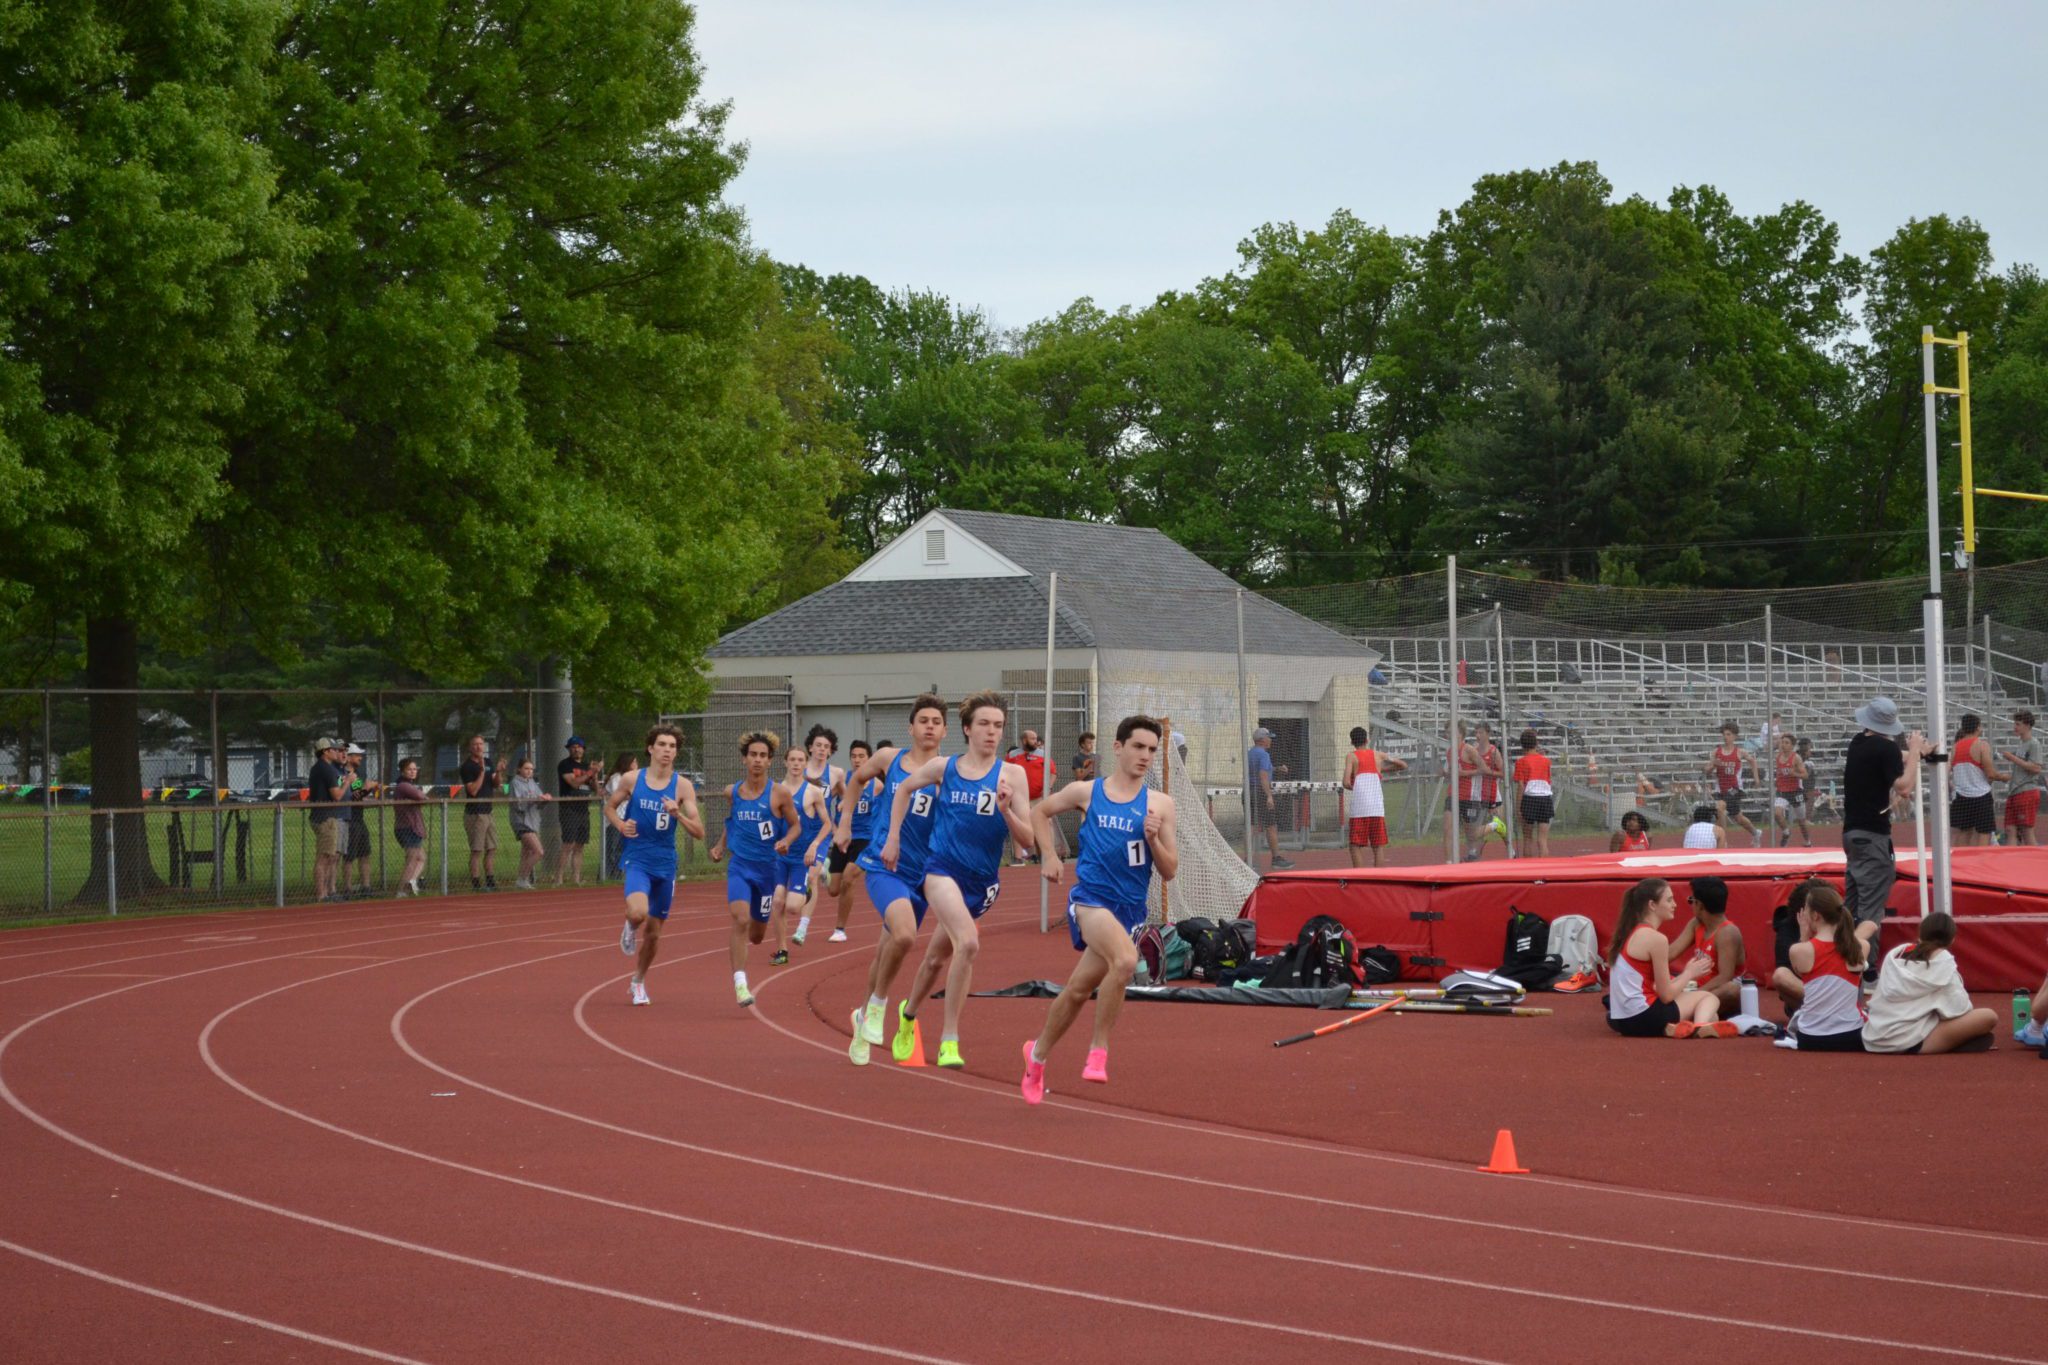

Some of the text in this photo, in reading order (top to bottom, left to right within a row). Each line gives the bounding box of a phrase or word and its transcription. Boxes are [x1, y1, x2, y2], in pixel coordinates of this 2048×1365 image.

[861, 802, 868, 813] 9
[915, 795, 928, 813] 3
[980, 793, 991, 813] 2
[659, 813, 667, 829] 5
[737, 811, 762, 820] HALL
[1098, 814, 1134, 832] HALL
[762, 822, 772, 837] 4
[1131, 842, 1141, 864] 1
[986, 886, 996, 905] 2
[763, 898, 771, 911] 4
